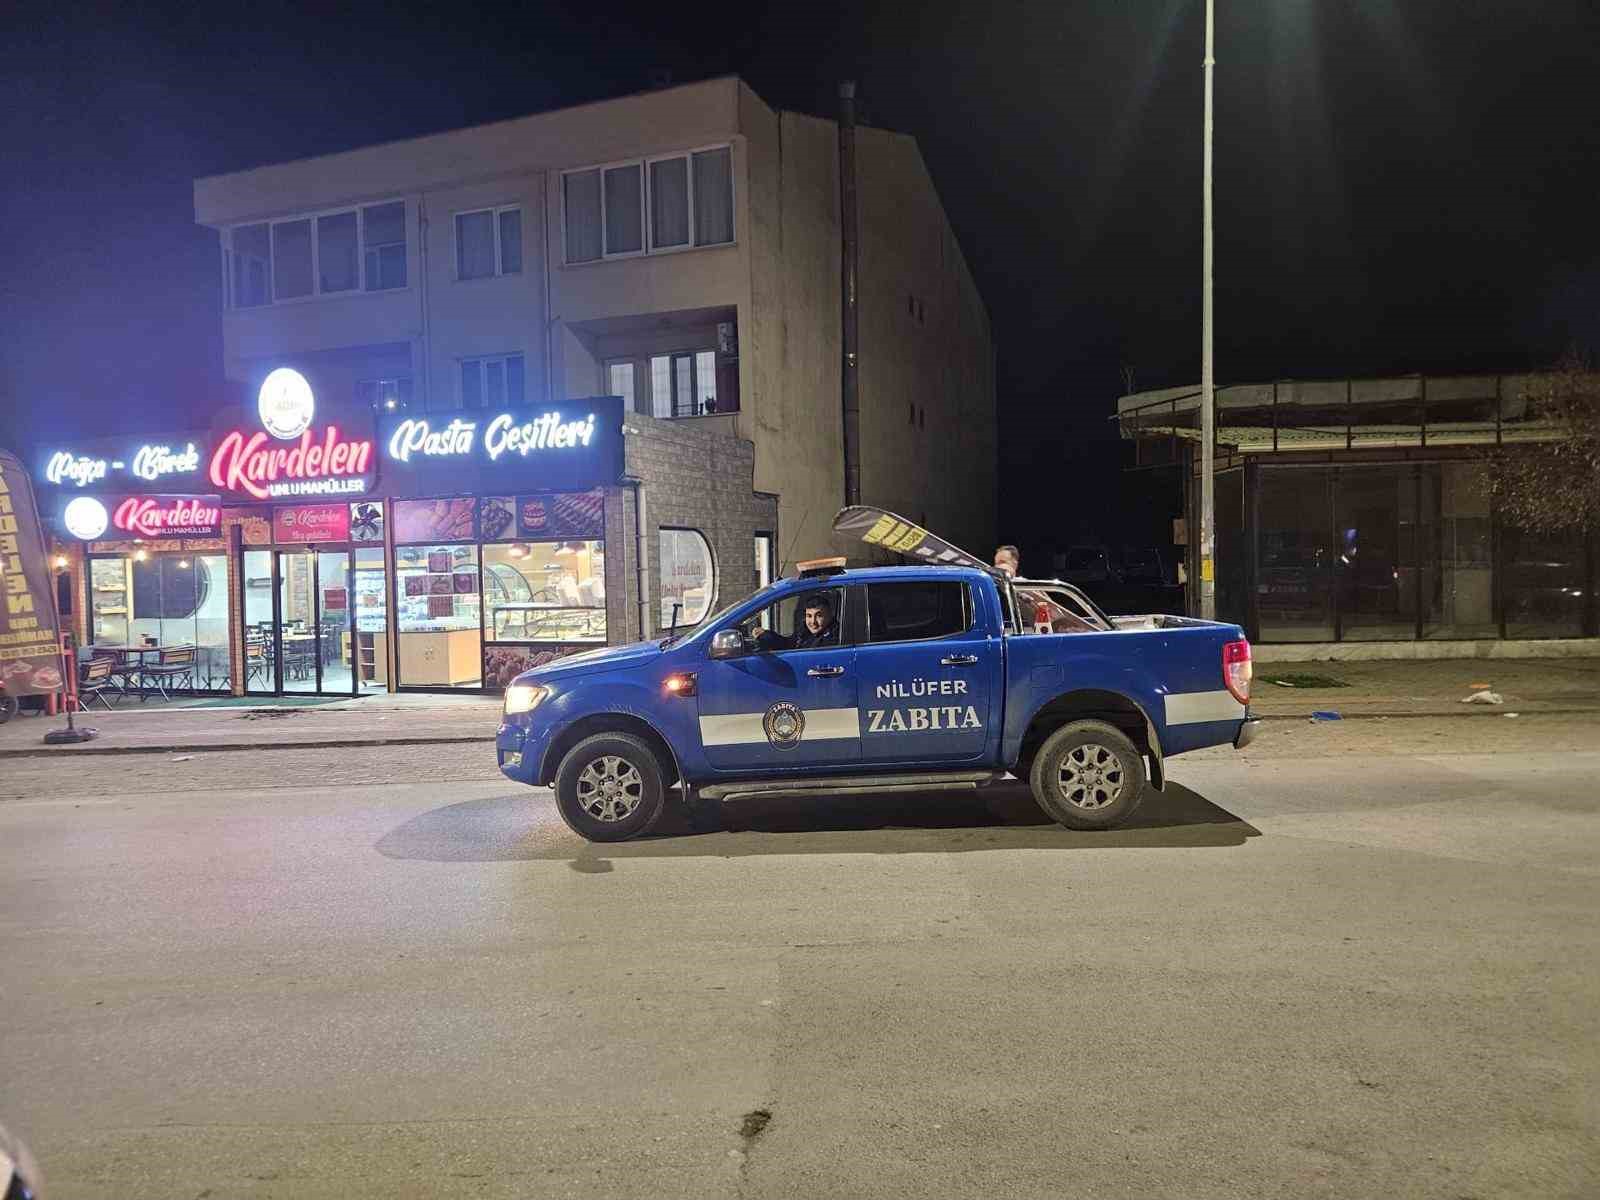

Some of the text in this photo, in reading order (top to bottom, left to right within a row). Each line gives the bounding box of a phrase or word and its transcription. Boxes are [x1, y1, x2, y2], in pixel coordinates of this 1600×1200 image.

[388, 411, 595, 462] Pasta Çeşitleri
[132, 443, 199, 480] Börek
[209, 426, 371, 499] Kardelen
[113, 497, 220, 537] Kardelen
[876, 678, 967, 698] NİLÜFER
[867, 705, 982, 733] ZABITA
